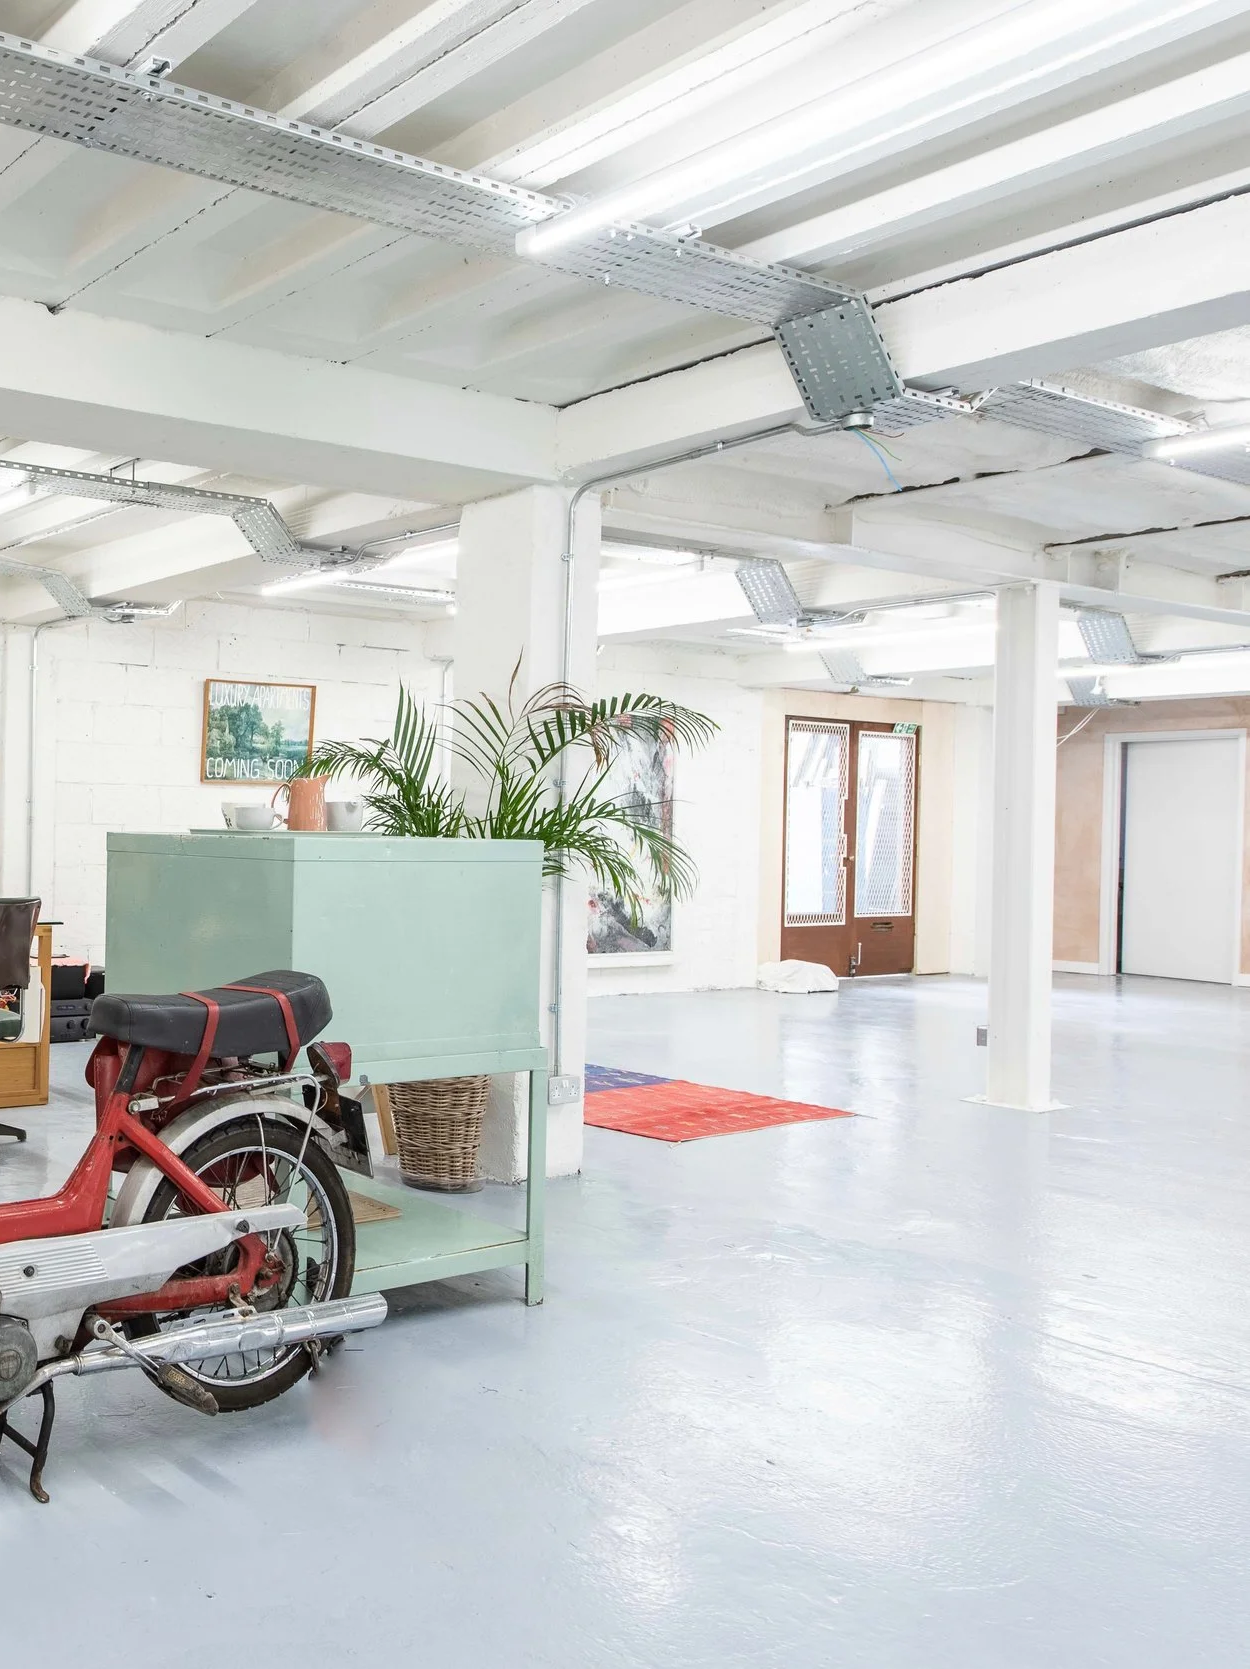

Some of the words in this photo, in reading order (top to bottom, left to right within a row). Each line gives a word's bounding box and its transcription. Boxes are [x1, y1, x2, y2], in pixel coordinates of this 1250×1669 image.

[209, 683, 250, 706] LUXURY
[251, 685, 310, 710] APARTMENTS
[206, 757, 260, 779] COMING
